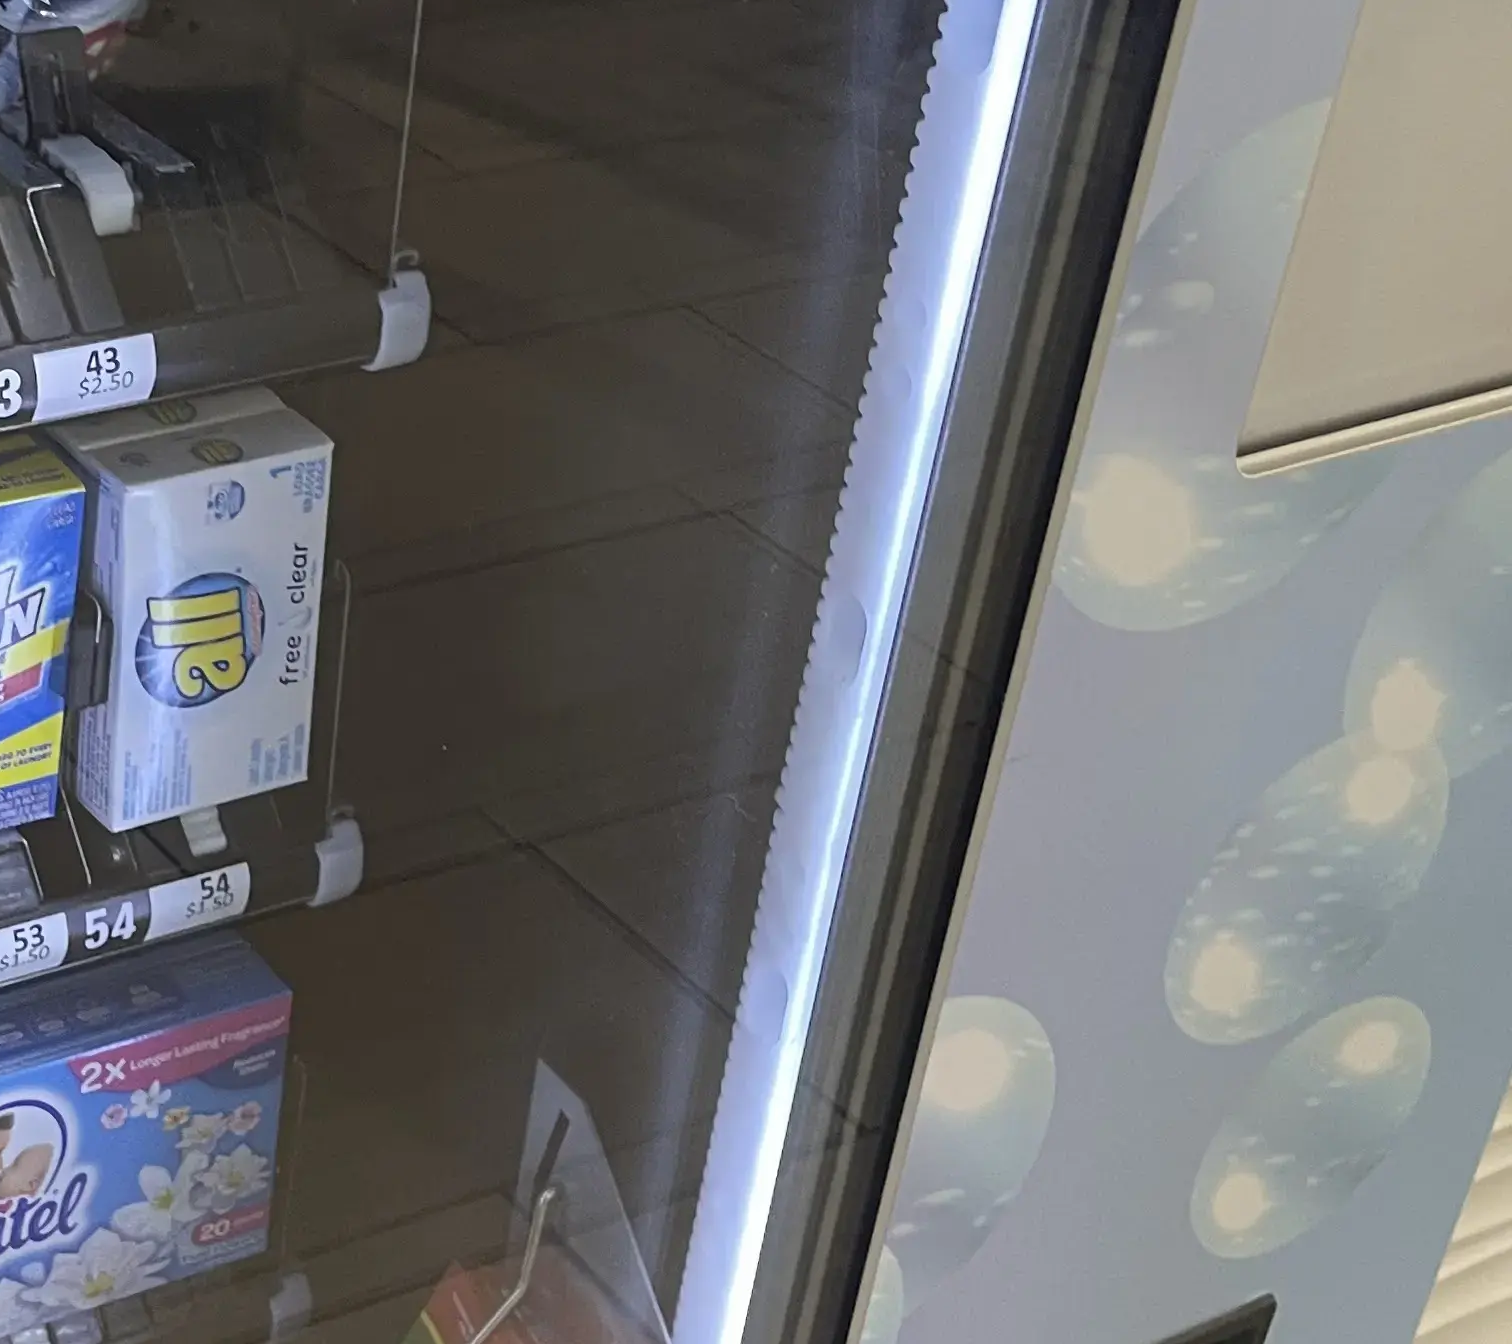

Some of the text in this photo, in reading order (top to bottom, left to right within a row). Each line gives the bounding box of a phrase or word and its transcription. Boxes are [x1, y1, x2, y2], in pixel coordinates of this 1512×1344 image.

[86, 347, 121, 376] 43
[78, 370, 134, 399] $2.50
[278, 543, 309, 686] free clear
[146, 586, 248, 699] all
[199, 872, 229, 900] 54
[186, 892, 234, 918] $1.50
[12, 923, 45, 951] 53
[84, 901, 136, 950] 54
[199, 1218, 230, 1242] 20
